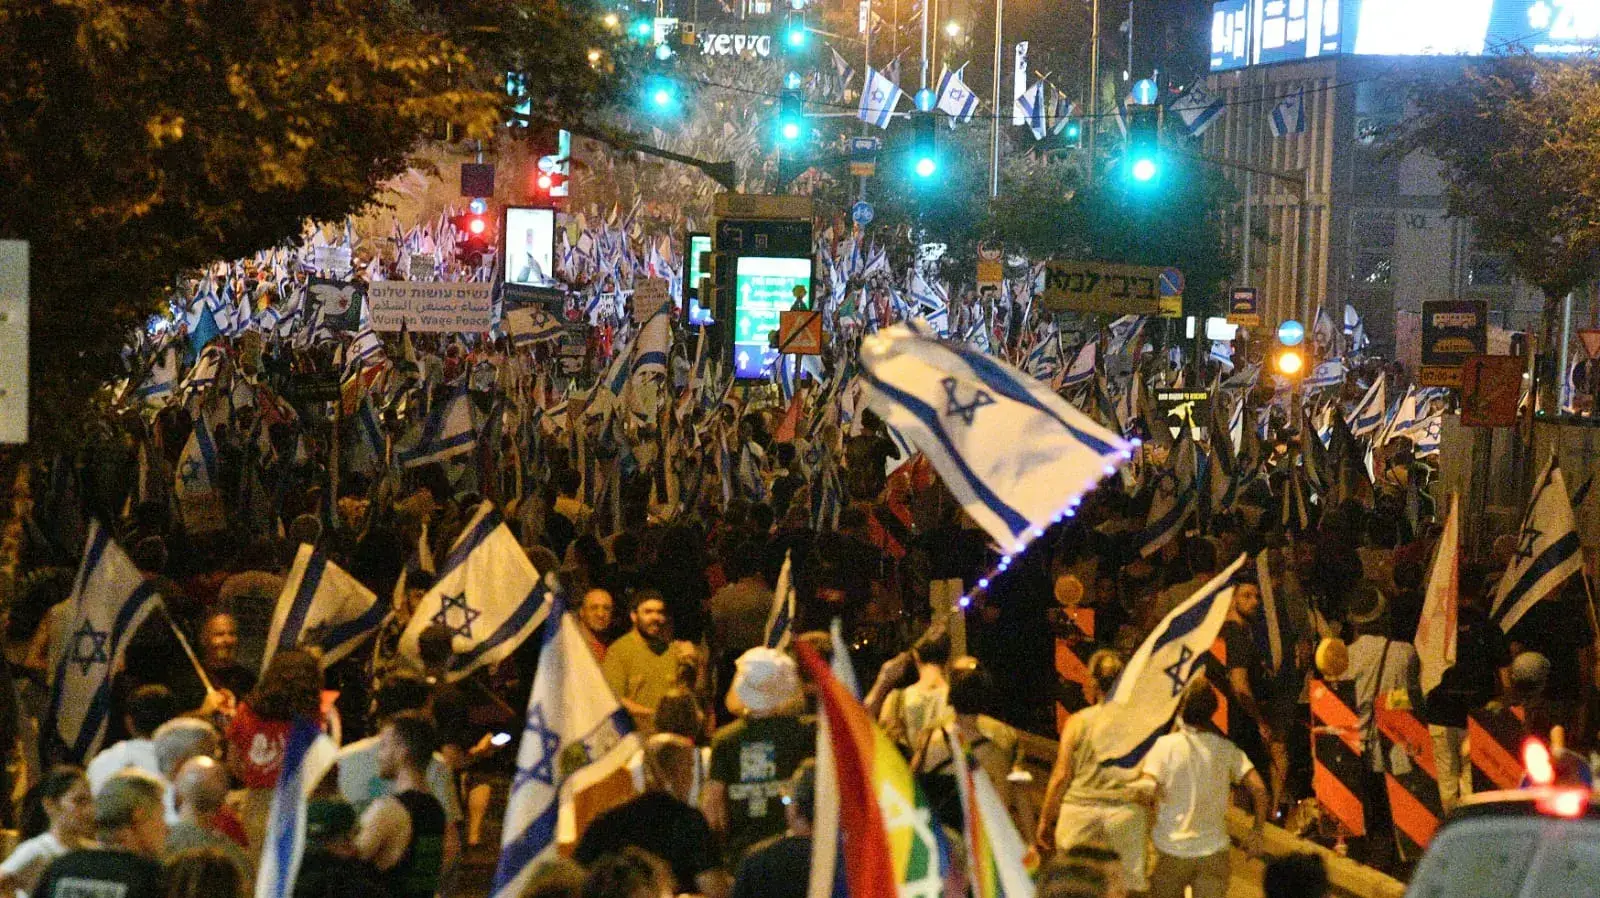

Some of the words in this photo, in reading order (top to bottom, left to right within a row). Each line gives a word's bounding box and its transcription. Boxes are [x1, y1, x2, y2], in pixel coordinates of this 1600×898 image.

[372, 286, 406, 298] שלום
[1103, 275, 1161, 299] ביבי
[411, 288, 453, 299] עושות
[456, 288, 490, 299] נשים
[460, 301, 490, 312] نساء
[420, 315, 453, 328] Wage
[456, 315, 491, 326] Peace
